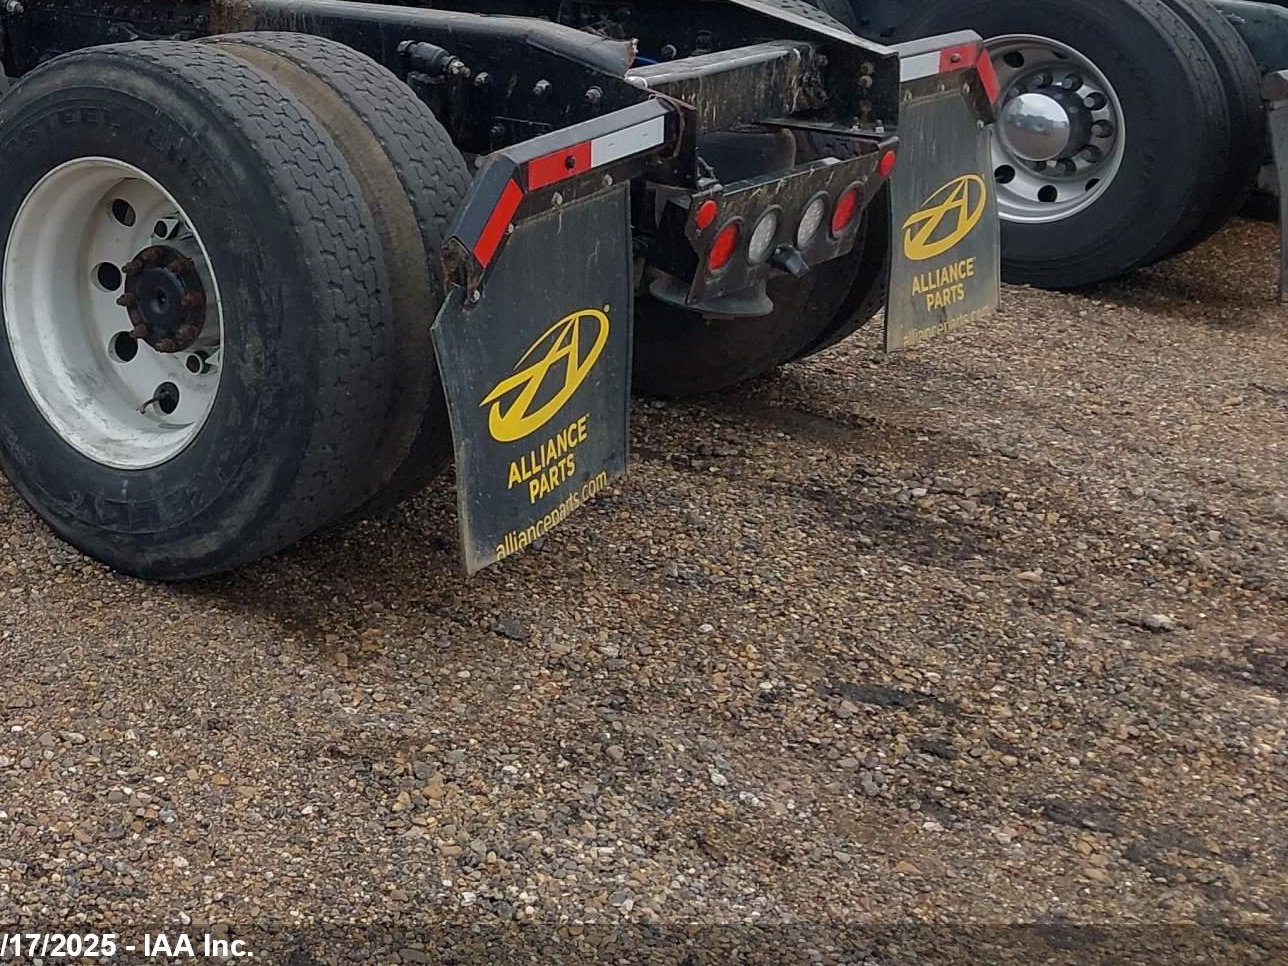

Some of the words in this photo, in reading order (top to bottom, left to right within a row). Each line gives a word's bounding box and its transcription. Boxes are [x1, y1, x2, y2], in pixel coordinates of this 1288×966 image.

[912, 257, 975, 296] ALLIANCE
[926, 282, 965, 312] PARTS
[508, 416, 588, 490] ALLIANCE
[529, 453, 576, 504] PARTS
[495, 470, 608, 561] allianceparts.com
